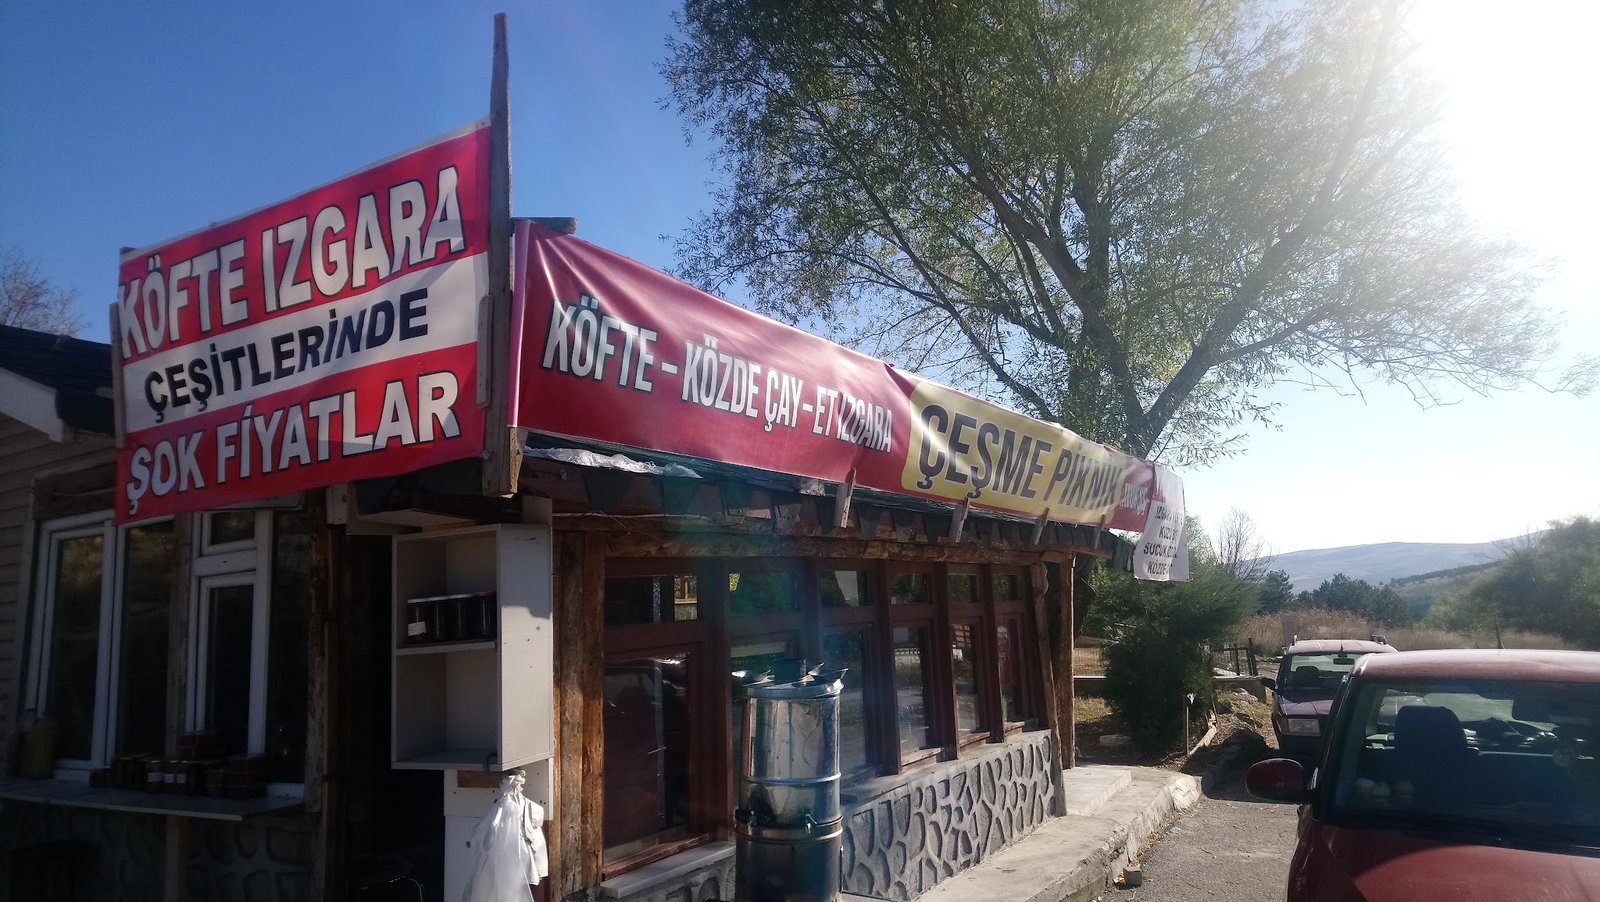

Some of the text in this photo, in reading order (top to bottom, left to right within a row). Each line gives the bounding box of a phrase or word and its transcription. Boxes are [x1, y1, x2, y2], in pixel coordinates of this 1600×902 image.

[118, 165, 466, 360] KÖFTE IZGARA
[144, 287, 428, 423] ÇEŞİTLERİNDE
[543, 294, 658, 393] KÖFTE
[682, 333, 761, 419] KÖZDE
[836, 391, 893, 453] IZGARA
[126, 371, 462, 516] ŞOK FİYATLAR
[916, 404, 1053, 499] ÇEŞME
